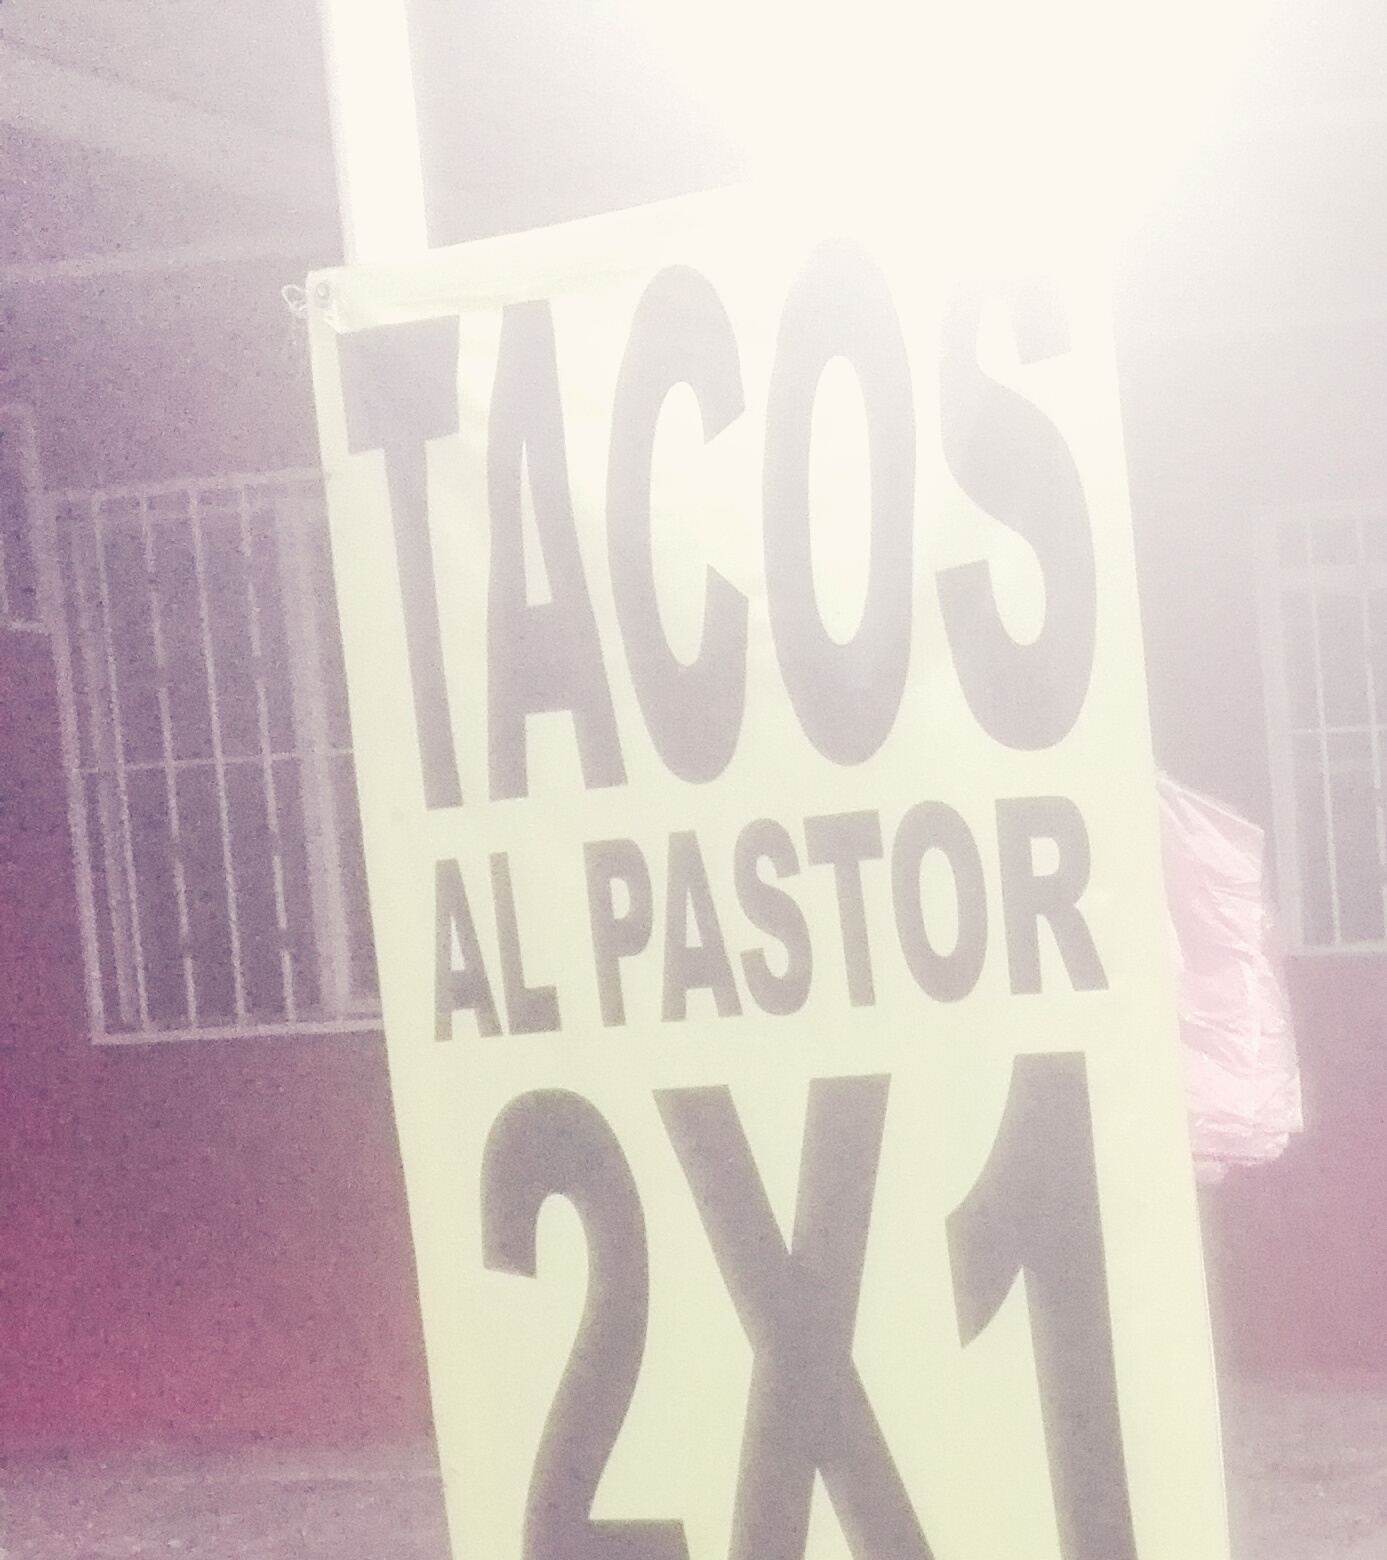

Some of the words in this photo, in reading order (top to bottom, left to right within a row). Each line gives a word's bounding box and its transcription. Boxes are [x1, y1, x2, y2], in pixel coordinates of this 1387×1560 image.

[336, 236, 1097, 810] TACOS
[433, 851, 563, 1043] AL
[582, 795, 1110, 1028] PASTOR
